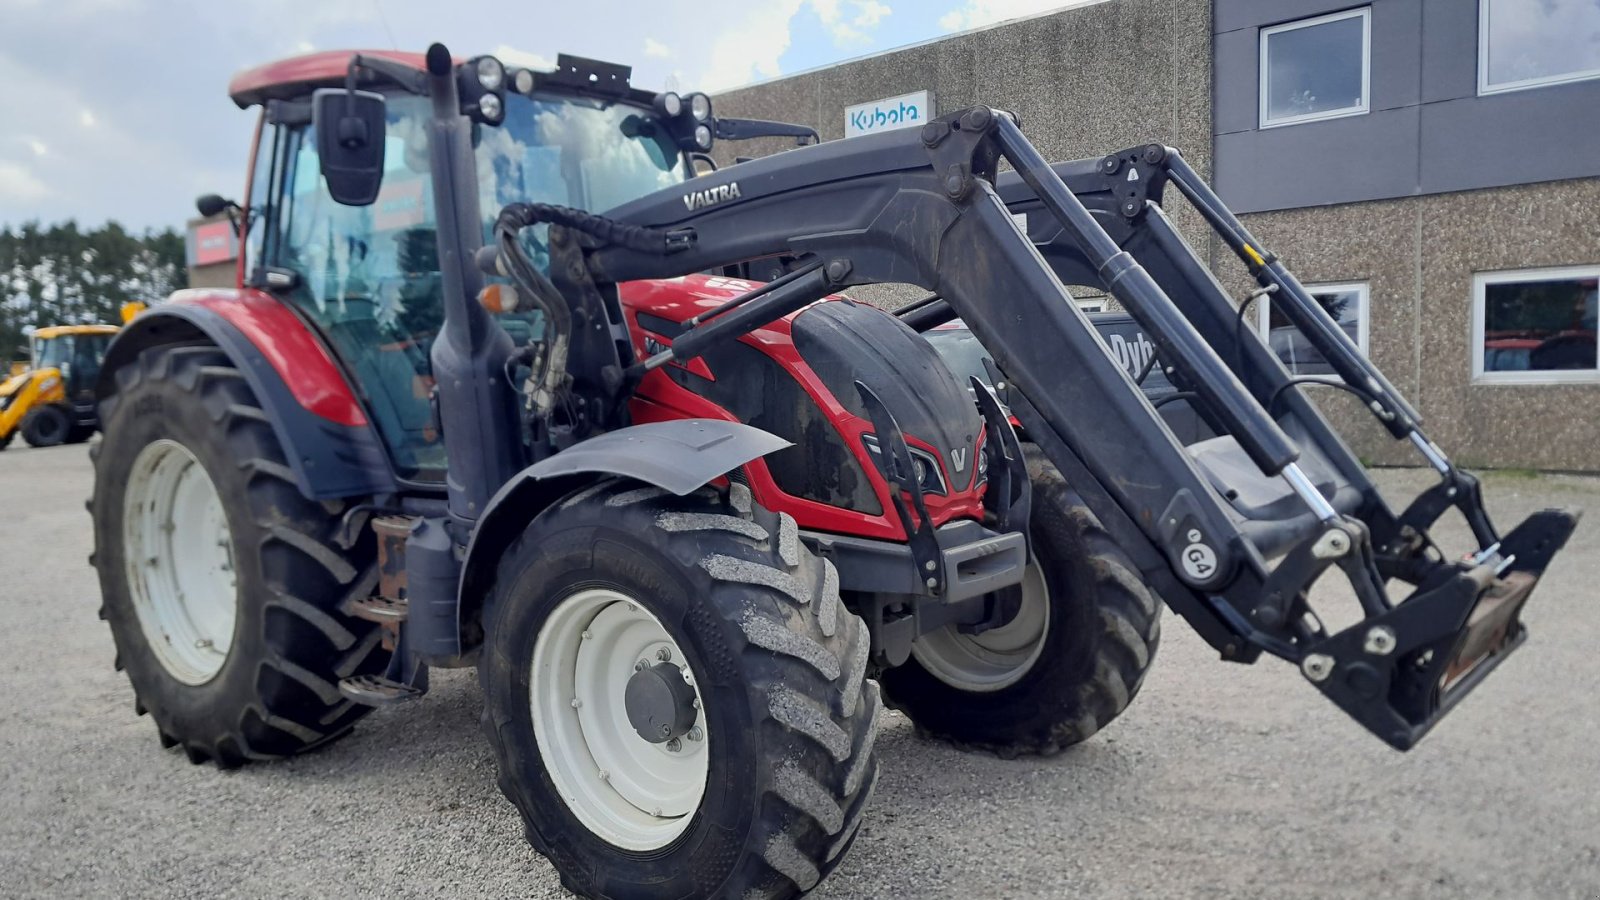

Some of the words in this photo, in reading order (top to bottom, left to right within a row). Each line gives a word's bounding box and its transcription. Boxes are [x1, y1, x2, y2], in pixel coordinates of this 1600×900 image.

[851, 101, 920, 130] Kubota
[683, 182, 742, 211] VALTRA
[950, 447, 966, 472] V
[1187, 548, 1213, 574] G4
